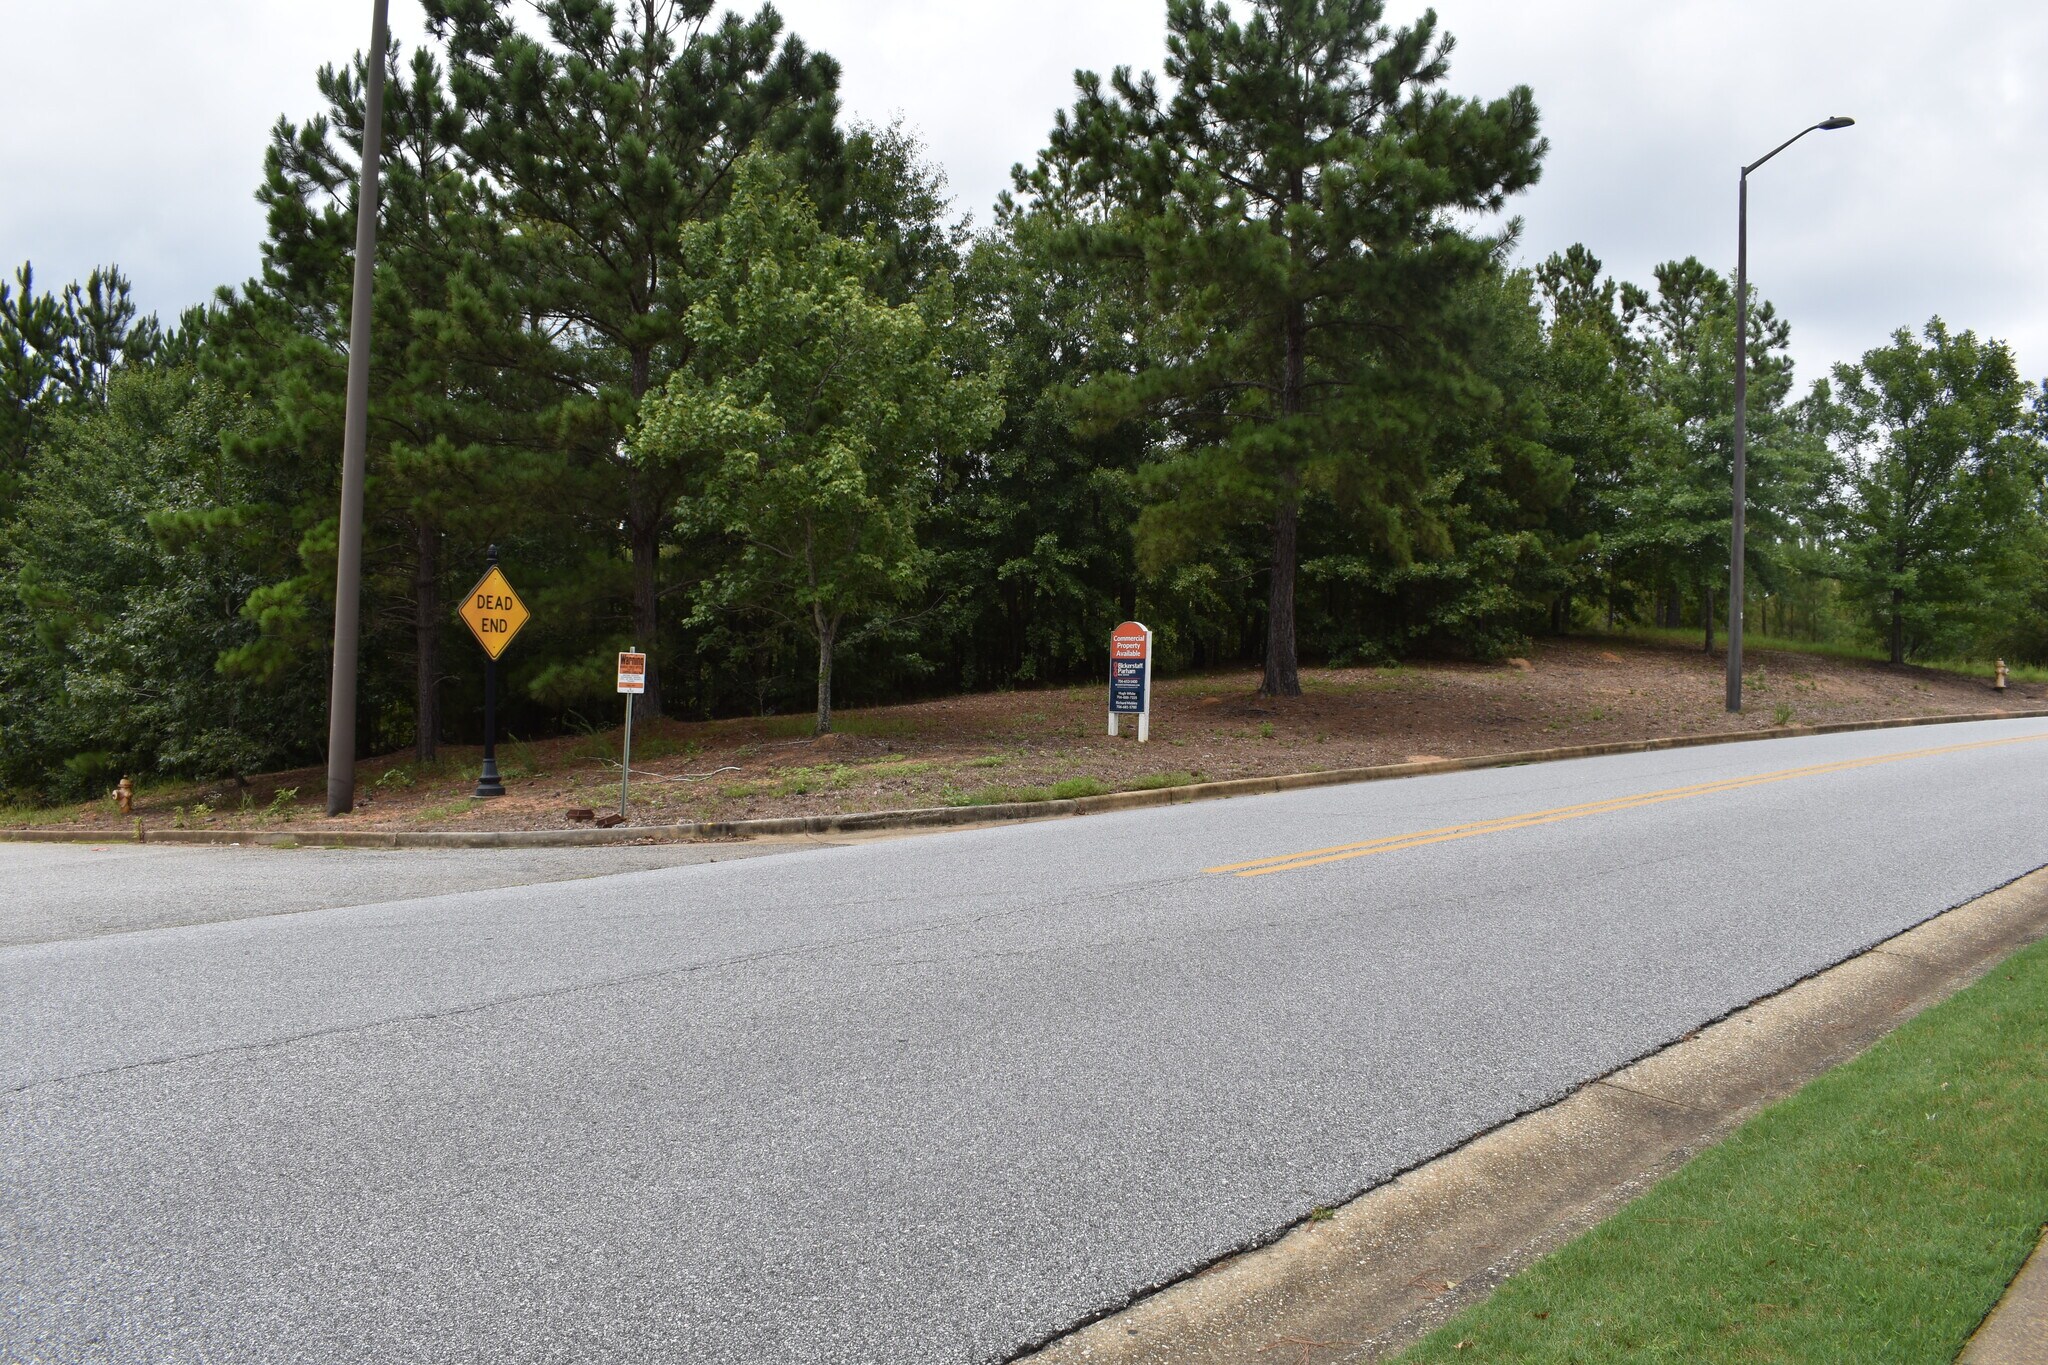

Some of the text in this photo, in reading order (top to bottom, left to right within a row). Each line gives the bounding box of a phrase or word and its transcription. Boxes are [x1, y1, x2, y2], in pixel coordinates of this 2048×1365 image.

[477, 594, 513, 611] DEAD
[481, 617, 508, 633] END
[1116, 642, 1141, 650] Property
[620, 654, 645, 666] Warning
